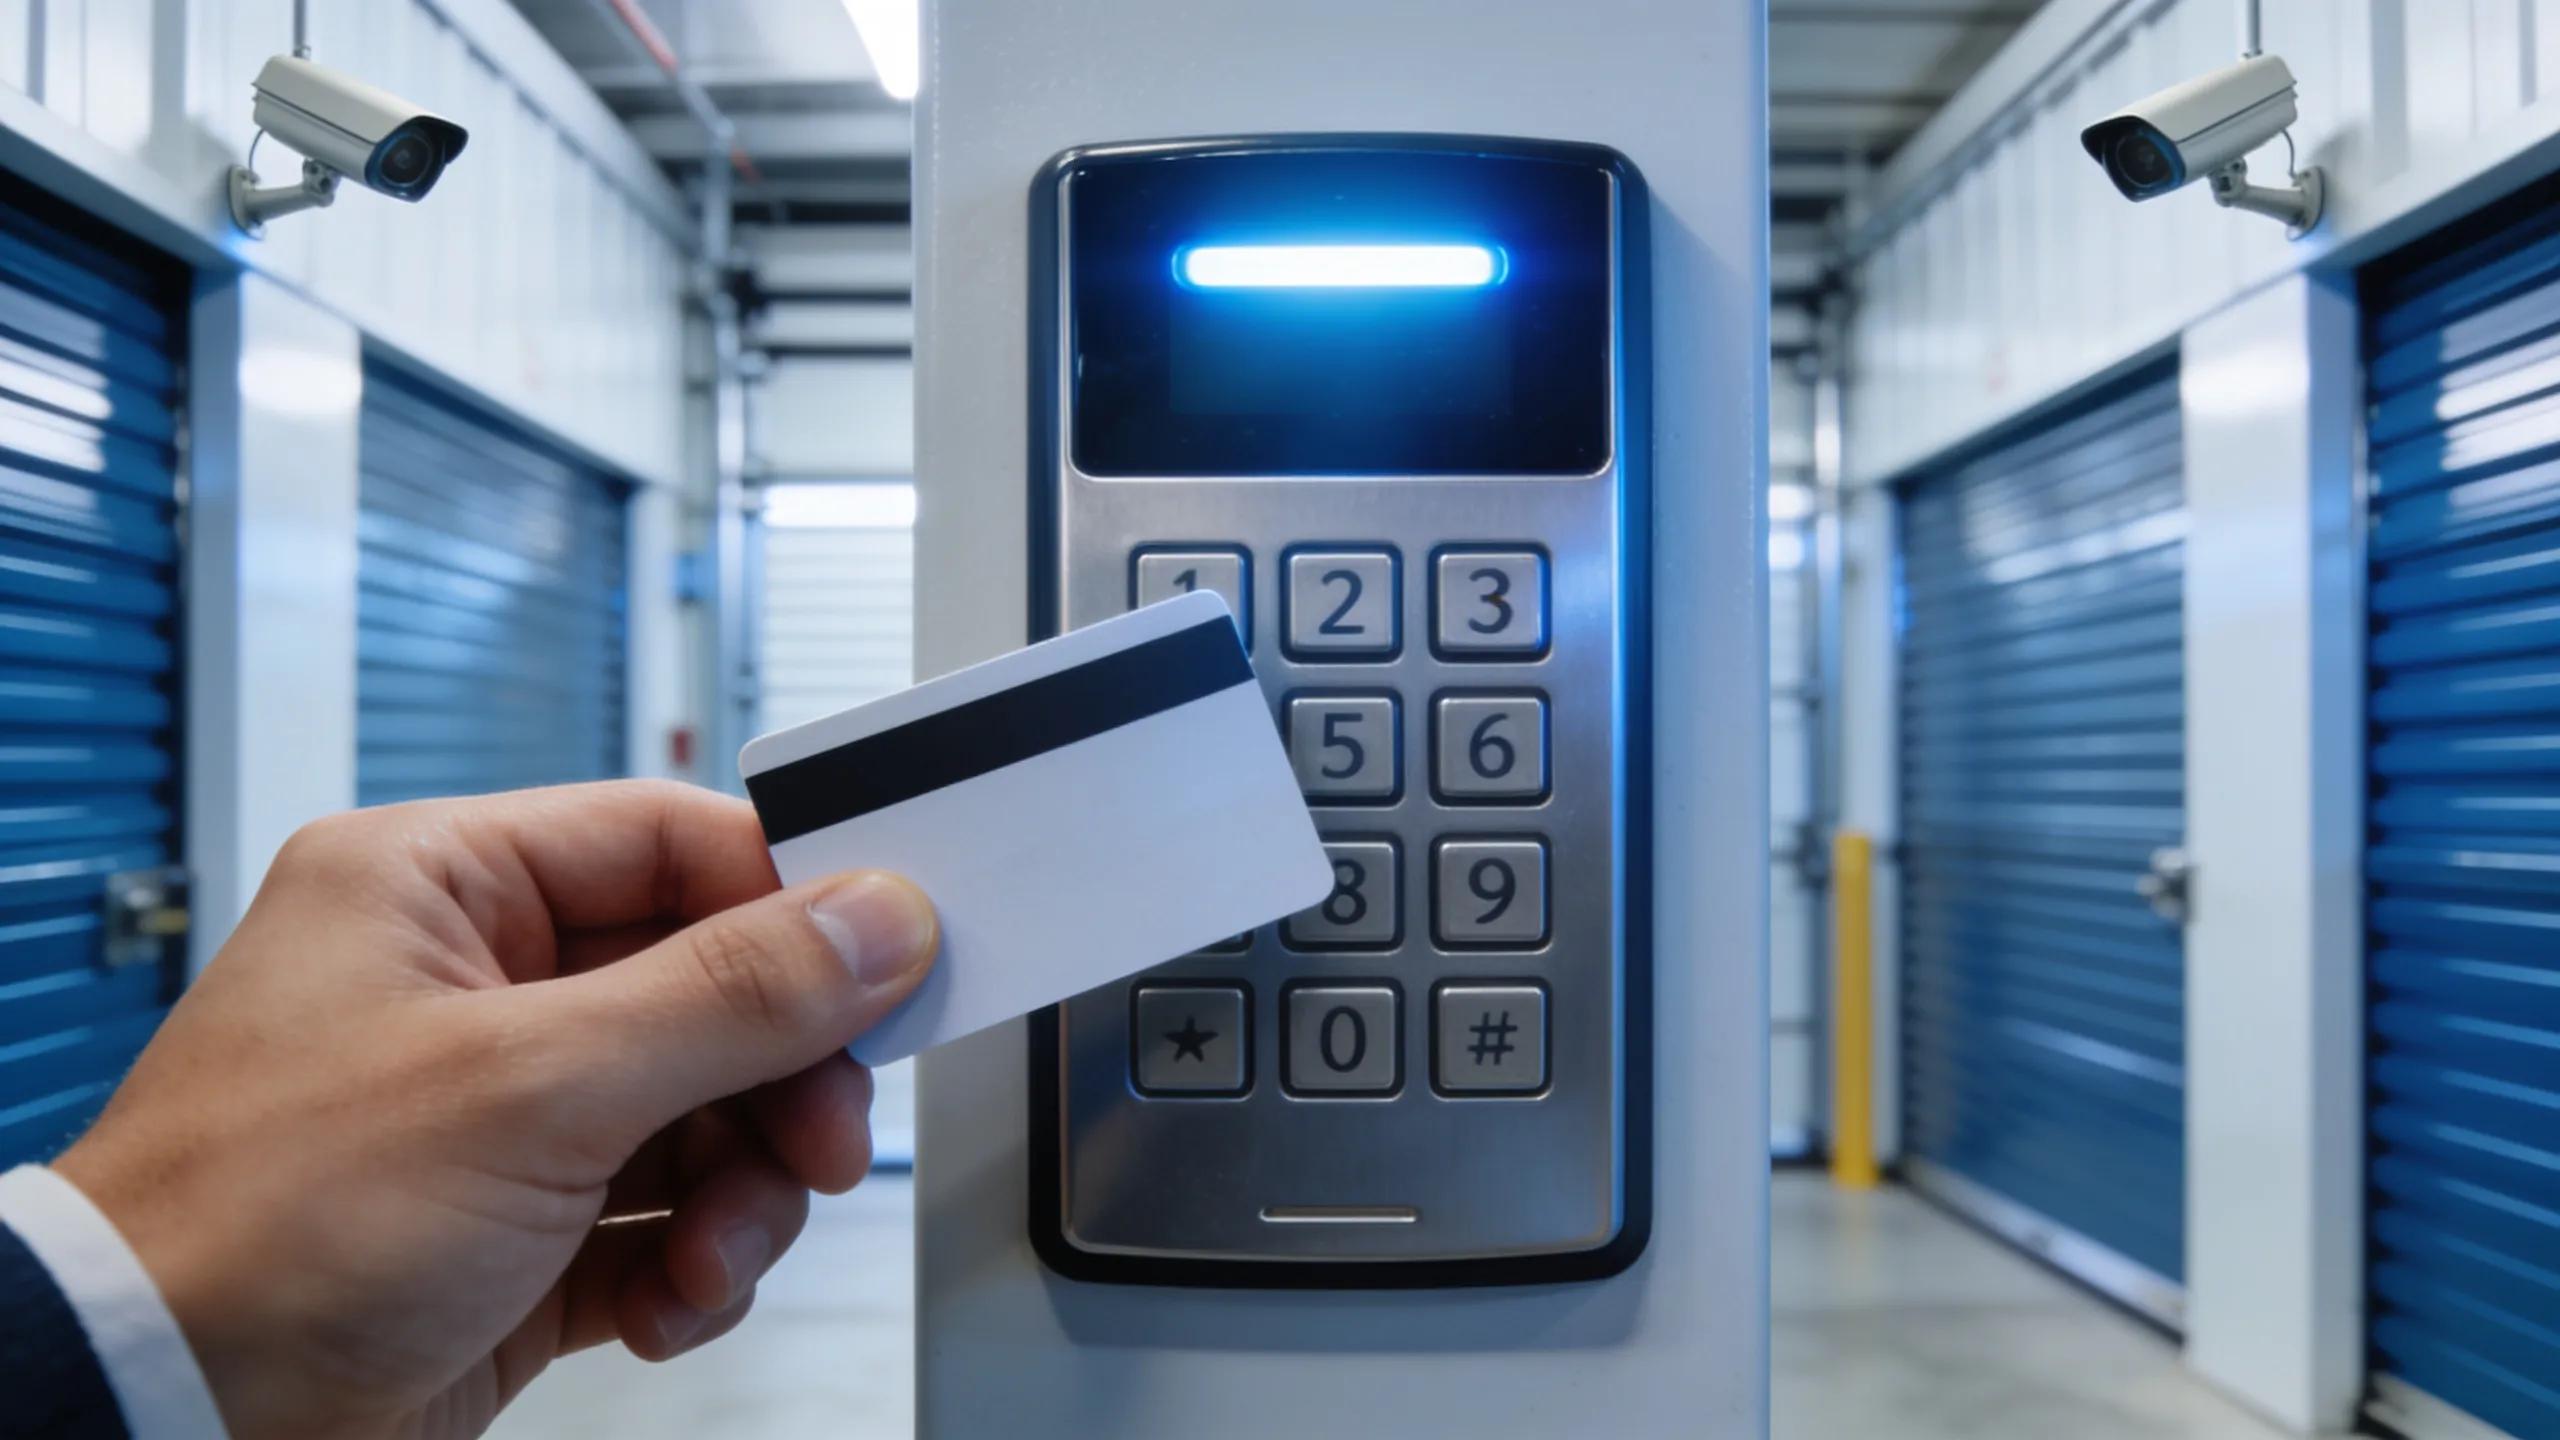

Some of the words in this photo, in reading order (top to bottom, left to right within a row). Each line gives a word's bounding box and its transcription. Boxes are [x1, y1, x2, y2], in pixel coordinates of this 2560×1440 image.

[1318, 569, 1365, 635] 2
[1468, 568, 1514, 635] 3
[1320, 712, 1365, 779] 5
[1468, 712, 1516, 779] 6
[1321, 858, 1367, 925] 8
[1468, 857, 1517, 925] 9
[1319, 1005, 1367, 1073] 0
[1467, 1010, 1518, 1066] #
